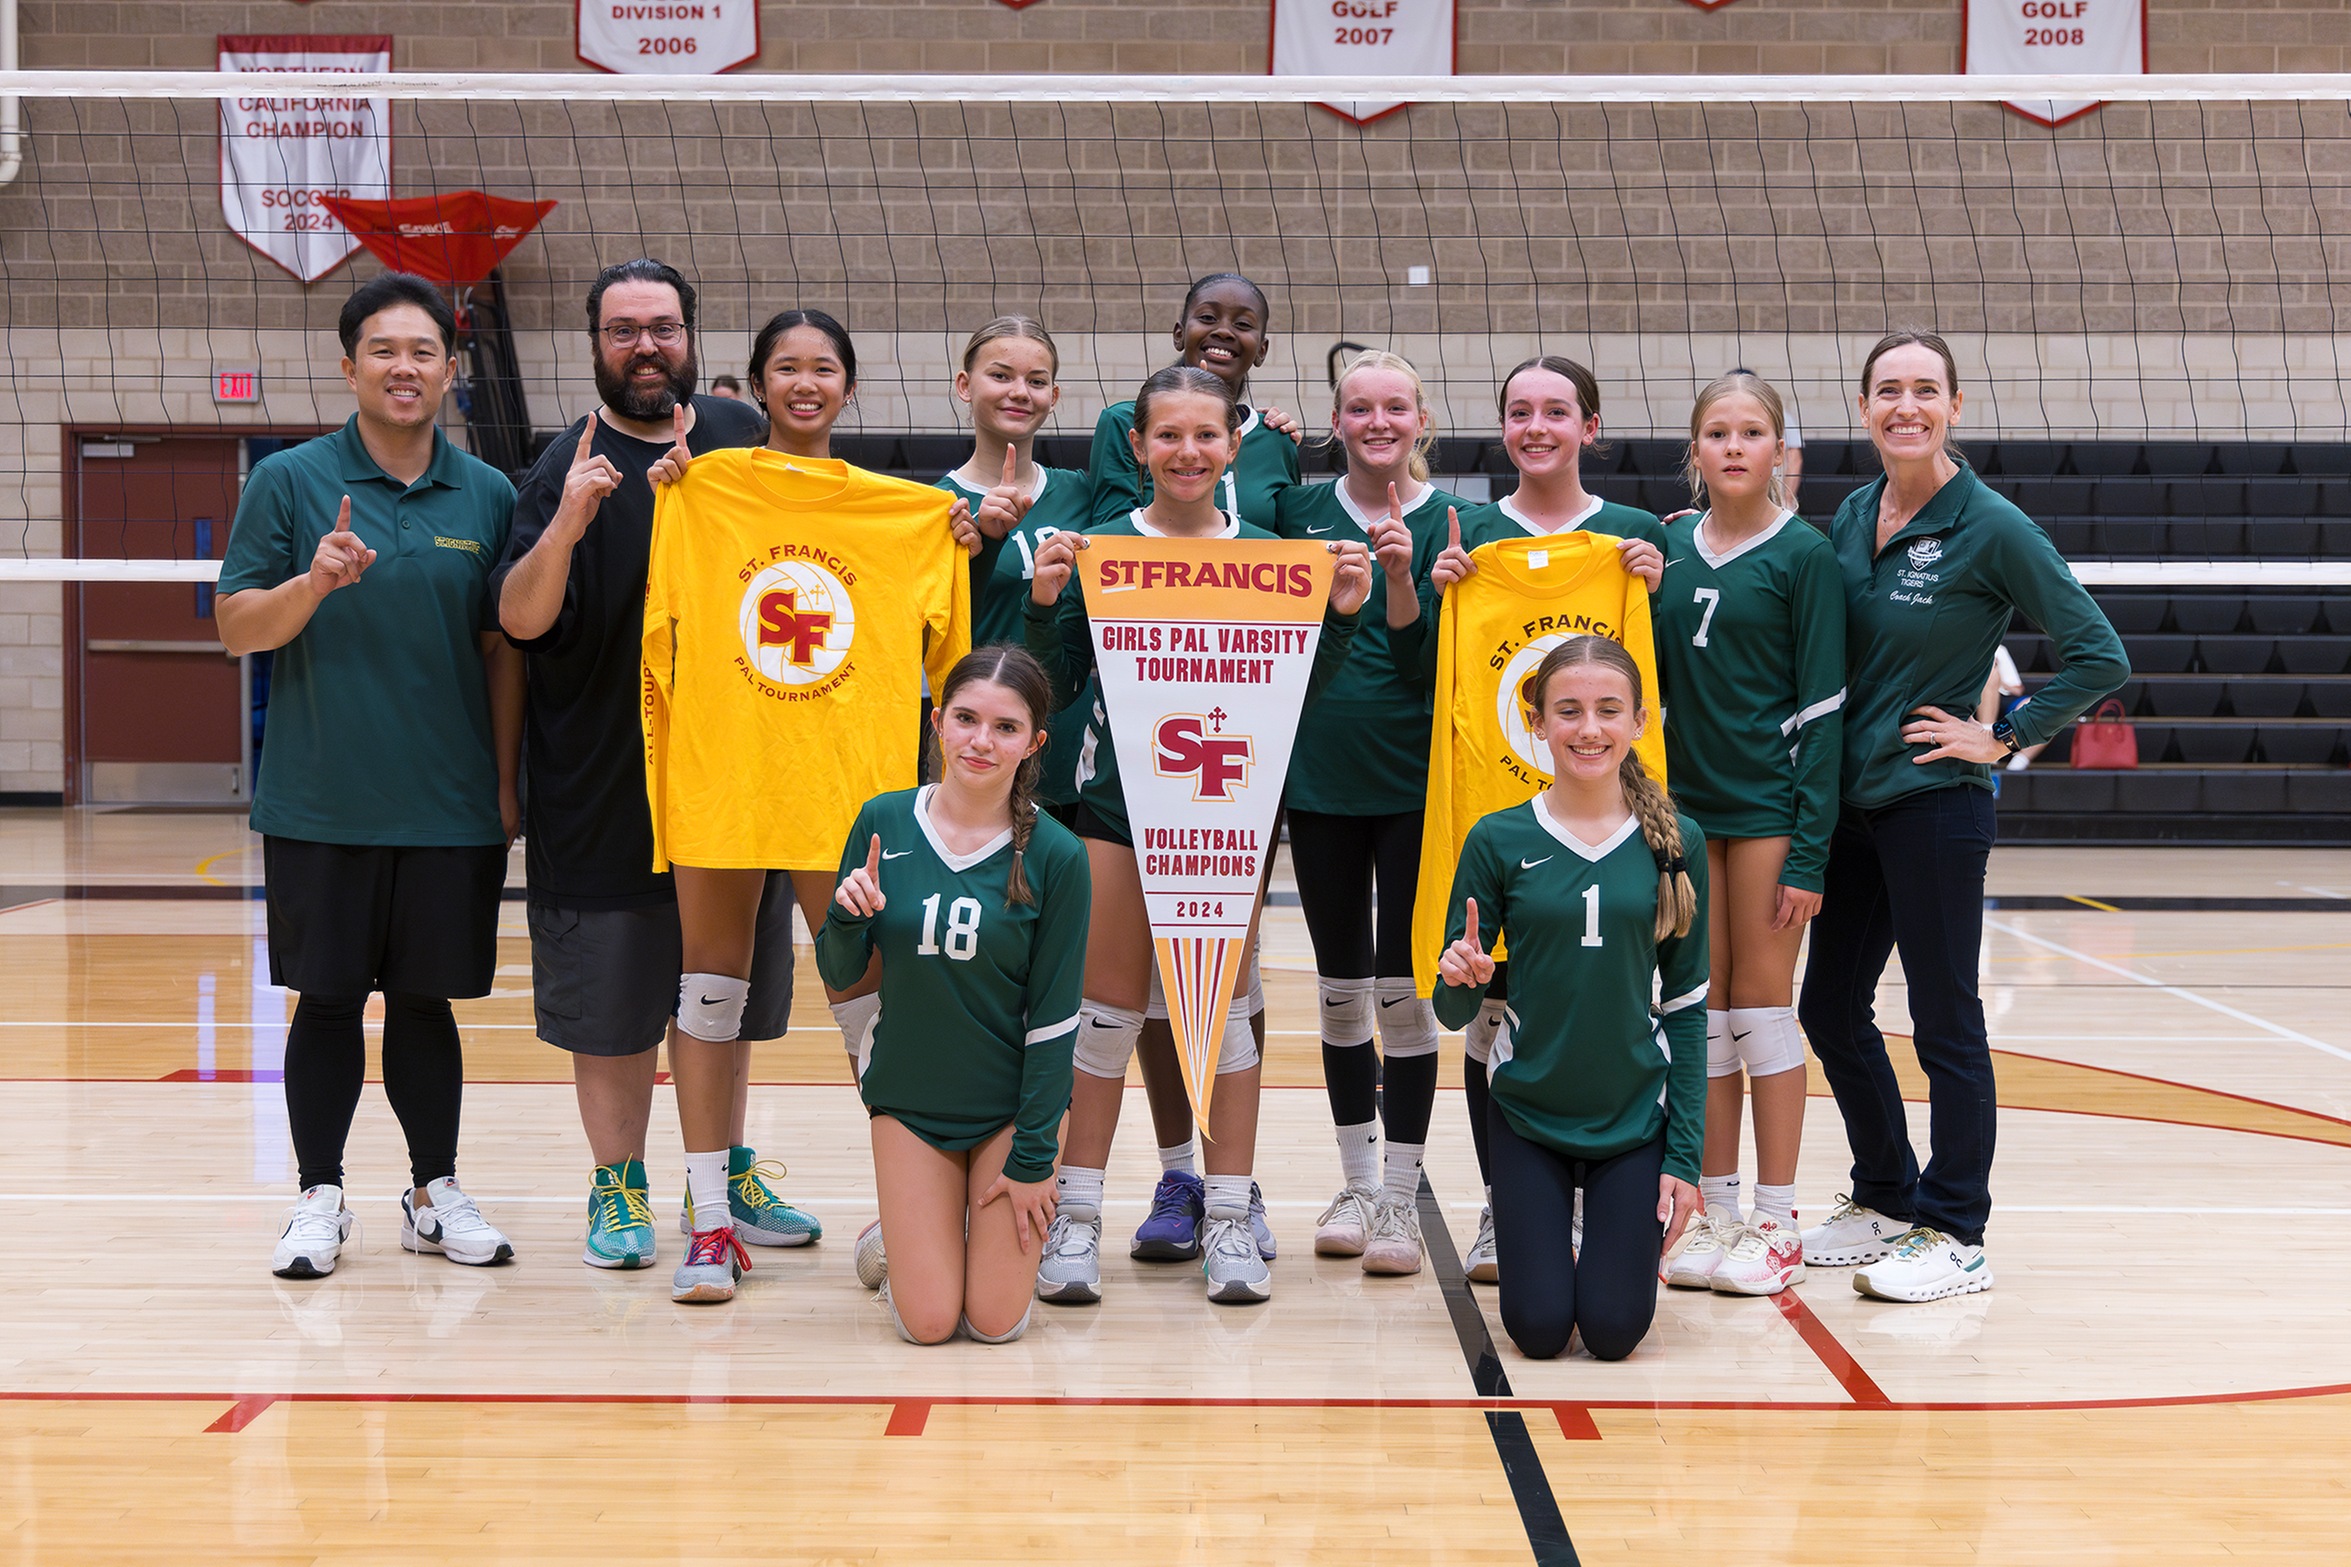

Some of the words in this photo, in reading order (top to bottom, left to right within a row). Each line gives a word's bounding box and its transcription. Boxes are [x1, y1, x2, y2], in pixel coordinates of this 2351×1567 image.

[612, 5, 704, 19] DIVISION
[712, 5, 721, 19] 1
[1331, 1, 1398, 17] GOLF
[2021, 2, 2088, 18] GOLF
[638, 37, 697, 55] 2006
[1335, 28, 1394, 45] 2007
[2024, 29, 2084, 45] 2008
[238, 97, 370, 112] CALIFORNIA
[246, 121, 363, 139] CHAMPION
[284, 213, 334, 231] 2024
[220, 373, 253, 399] EXIT
[1011, 525, 1061, 580] 1
[738, 557, 765, 584] ST.
[769, 544, 857, 587] FRANCIS
[1901, 578, 1925, 588] TIGERS
[1889, 590, 1913, 602] Coach
[758, 590, 833, 664] SF
[1692, 587, 1720, 648] 7
[1102, 626, 1162, 652] GIRLS
[1170, 627, 1209, 653] PAL
[1217, 628, 1309, 655] VARSITY
[1489, 640, 1520, 671] ST.
[733, 656, 755, 686] PAL
[757, 661, 856, 702] TOURNAMENT
[1135, 657, 1275, 684] TOURNAMENT
[1155, 715, 1252, 800] SF
[1499, 755, 1530, 785] PAL
[1144, 828, 1259, 851] VOLLEYBALL
[1145, 854, 1256, 877] CHAMPIONS
[1176, 901, 1224, 918] 2024
[1581, 884, 1604, 947] 1
[917, 892, 982, 961] 18
